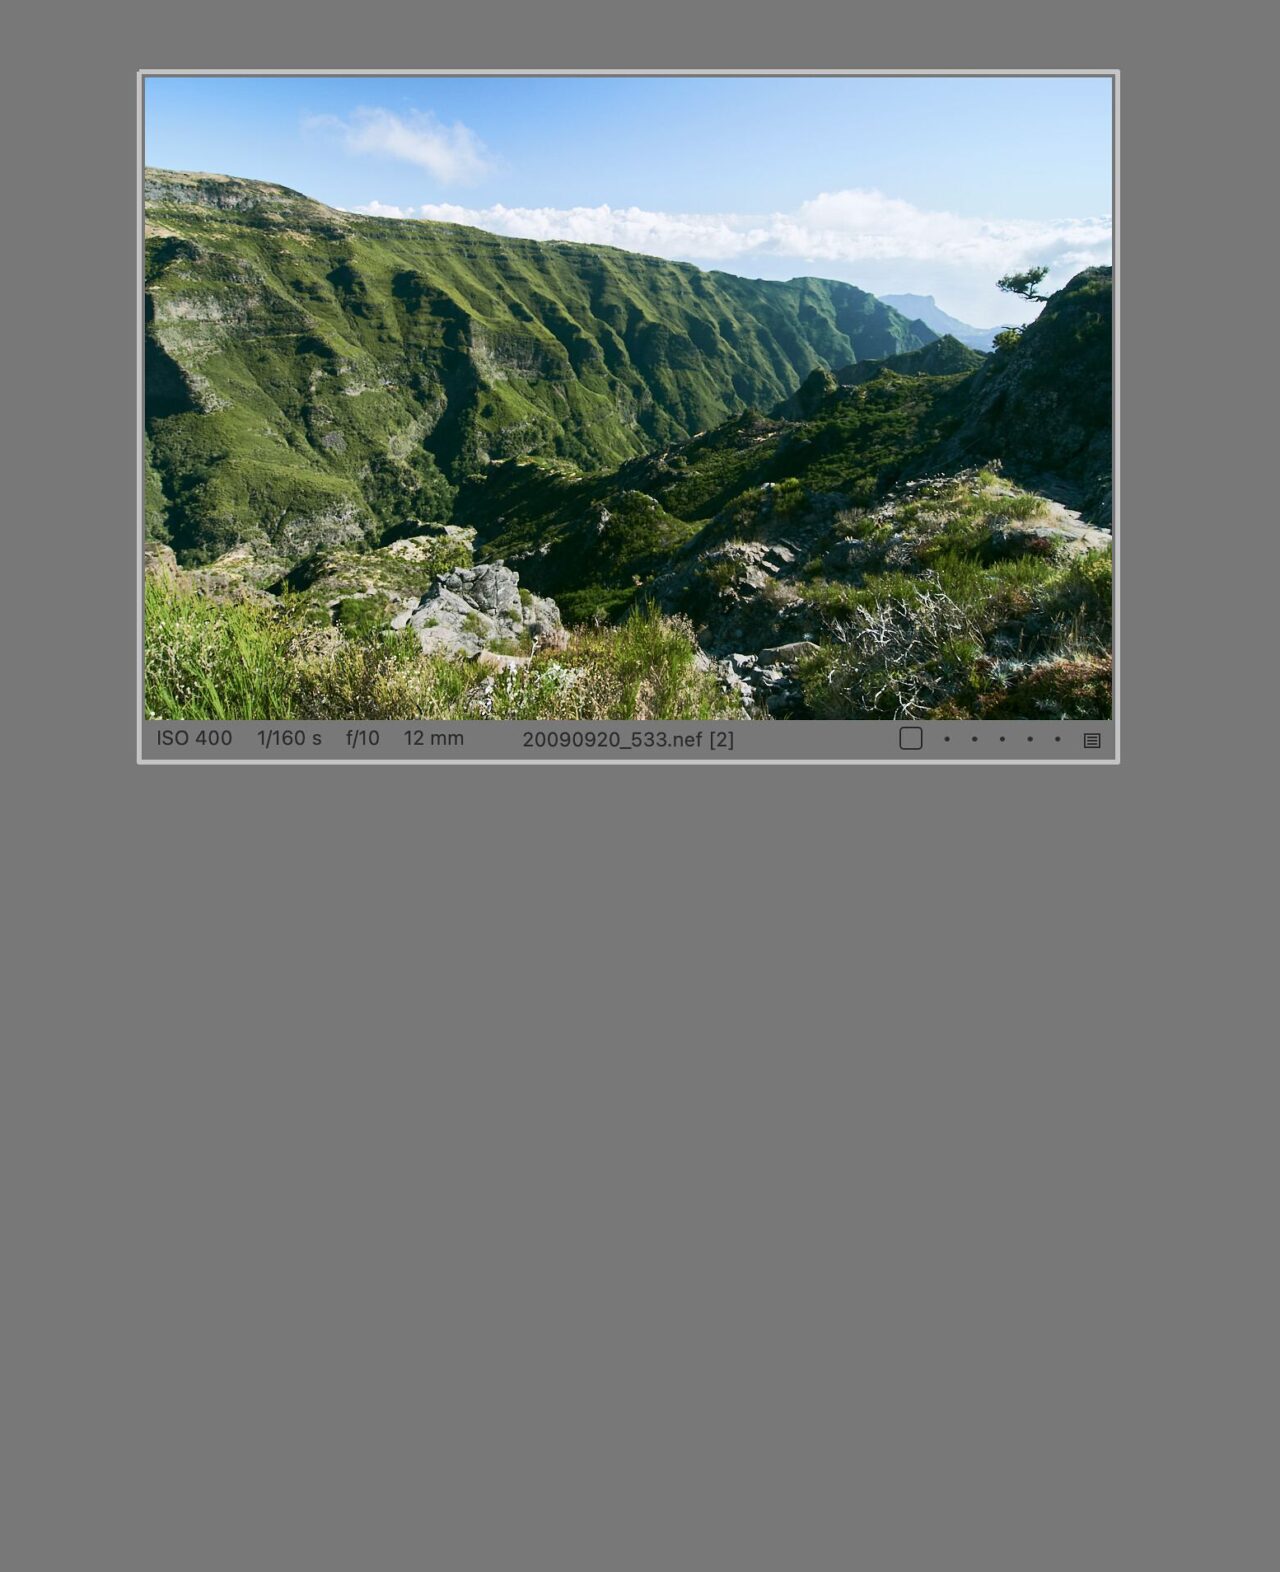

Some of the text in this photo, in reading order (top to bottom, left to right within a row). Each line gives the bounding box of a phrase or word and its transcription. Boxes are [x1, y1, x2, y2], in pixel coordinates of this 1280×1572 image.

[157, 729, 464, 750] ISO 400 1/160 s f/10 12 mm
[522, 730, 734, 751] 20090920_533.nef [2]
